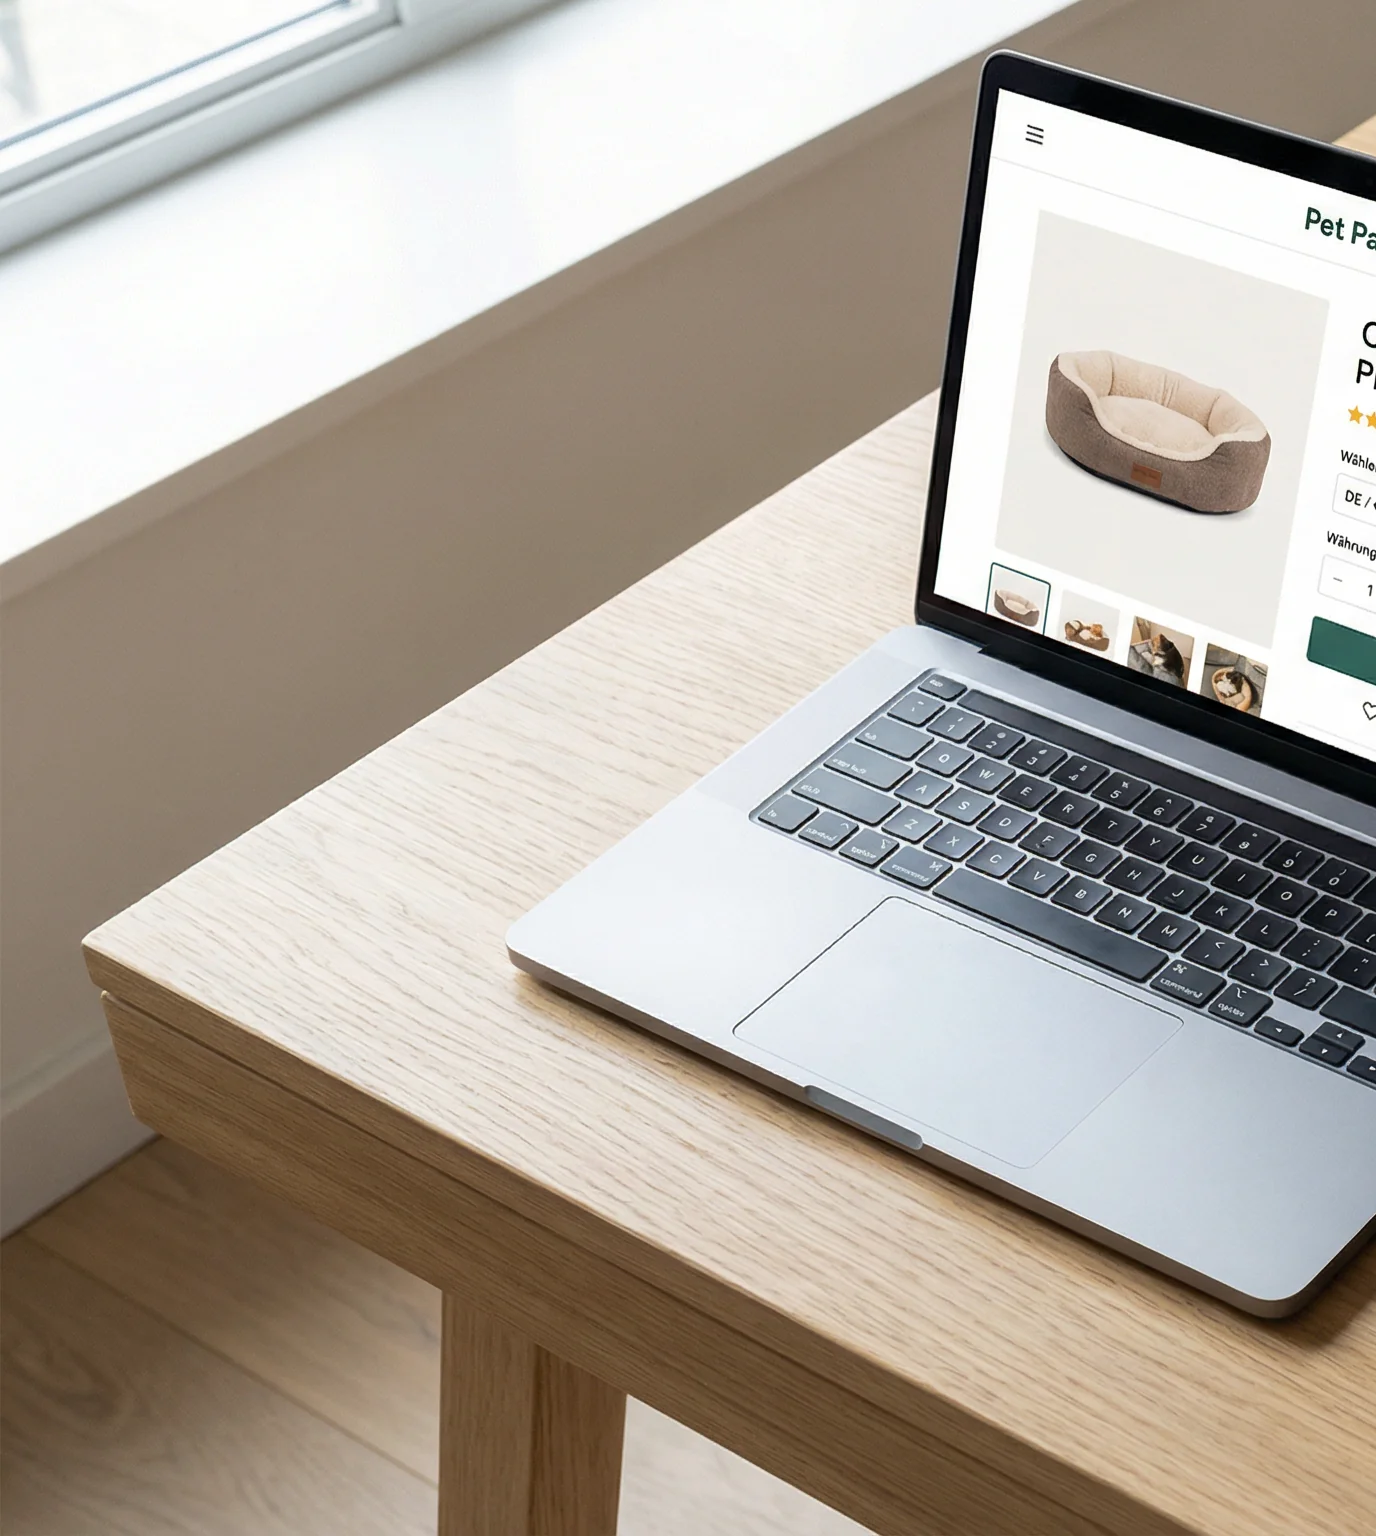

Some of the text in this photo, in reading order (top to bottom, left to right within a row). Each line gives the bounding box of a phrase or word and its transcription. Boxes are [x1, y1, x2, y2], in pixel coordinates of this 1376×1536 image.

[1304, 206, 1345, 241] Pet
[1345, 490, 1362, 507] DE
[1367, 585, 1373, 597] 1
[985, 740, 997, 749] 2
[1026, 756, 1038, 765] 3
[978, 769, 995, 780] W
[915, 784, 928, 795] A
[1019, 786, 1033, 797] E
[1110, 790, 1122, 799] 5
[957, 801, 970, 811] S
[1061, 803, 1074, 814] R
[1153, 807, 1164, 816] 6
[903, 819, 919, 830] Z
[998, 817, 1012, 827] D
[1107, 820, 1118, 830] T
[1196, 824, 1208, 832] 7
[946, 836, 960, 847] X
[1042, 835, 1055, 843] F
[1150, 838, 1161, 847] Y
[989, 854, 1002, 864] C
[1084, 853, 1097, 863] G
[1192, 855, 1205, 865] U
[1033, 870, 1046, 881] V
[1126, 870, 1141, 880] H
[1172, 889, 1184, 898] J
[1280, 891, 1293, 900] O
[1118, 907, 1132, 918] N
[1215, 906, 1228, 917] K
[1325, 908, 1338, 918] P
[1161, 925, 1178, 937] M
[1260, 924, 1269, 935] L
